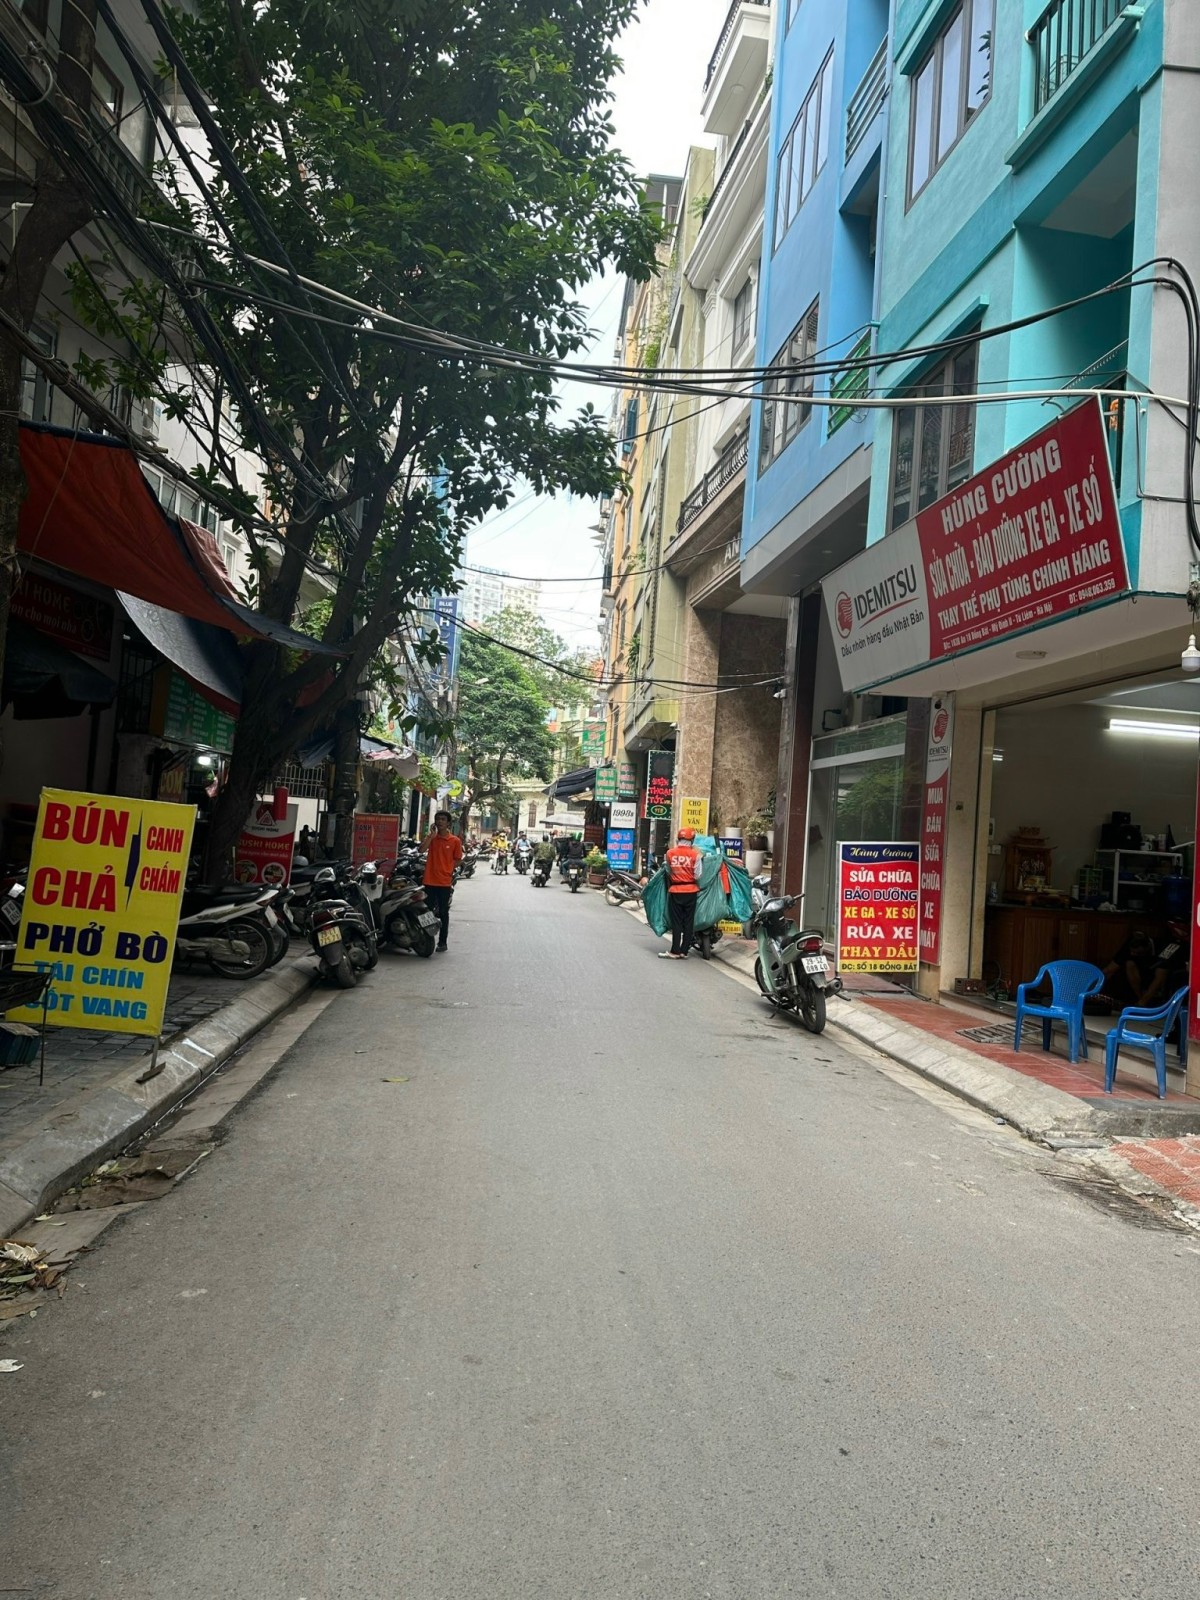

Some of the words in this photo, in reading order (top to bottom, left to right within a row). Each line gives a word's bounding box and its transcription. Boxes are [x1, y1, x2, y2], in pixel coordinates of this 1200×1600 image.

[940, 485, 989, 535] HÙNG
[991, 439, 1061, 504] CƯỜNG
[929, 548, 949, 599] SỬA
[945, 542, 971, 592] CHỮA
[972, 522, 995, 578] BẢO
[991, 512, 1029, 568] DƯỠNG
[1025, 506, 1043, 553] XE
[1040, 497, 1061, 546] GA
[1063, 483, 1084, 535] XE
[1082, 454, 1103, 526] SỐ
[854, 564, 917, 621] IDEMITSU
[937, 610, 960, 631] THAY
[960, 590, 980, 617] THẾ
[979, 588, 1001, 613] PHỤ
[1001, 573, 1031, 604] TÙNG
[1033, 558, 1071, 592] CHÍNH
[1071, 539, 1111, 576] HÃNG
[927, 787, 943, 805] MUA
[687, 808, 703, 816] THUÊ
[926, 812, 942, 833] BÁN
[42, 801, 130, 848] BÚN
[146, 826, 184, 853] CANH
[671, 855, 692, 866] SPX
[850, 847, 879, 859] Hùng
[882, 847, 914, 860] Cường
[925, 840, 940, 862] SỬA
[140, 861, 182, 894] CHẤM
[849, 866, 875, 883] SỬA
[878, 869, 913, 883] CHỮA
[921, 871, 940, 891] CHỮA
[32, 865, 116, 912] CHẢ
[844, 886, 871, 901] BẢO
[873, 886, 918, 901] DƯỠNG
[844, 906, 858, 918] XE
[860, 906, 875, 918] GA
[885, 906, 899, 919] XE
[901, 903, 916, 919] SỐ
[924, 902, 934, 920] XE
[847, 922, 885, 939] RỬA
[892, 926, 914, 940] XE
[920, 928, 937, 949] MÁY
[24, 921, 106, 957] PHỞ
[115, 931, 168, 964] BÒ
[840, 946, 883, 958] THAY
[886, 941, 918, 958] DẦU
[34, 960, 74, 982] TÁI
[82, 967, 144, 989] CHÍN
[857, 961, 868, 970] SỐ
[82, 996, 148, 1020] VANG
